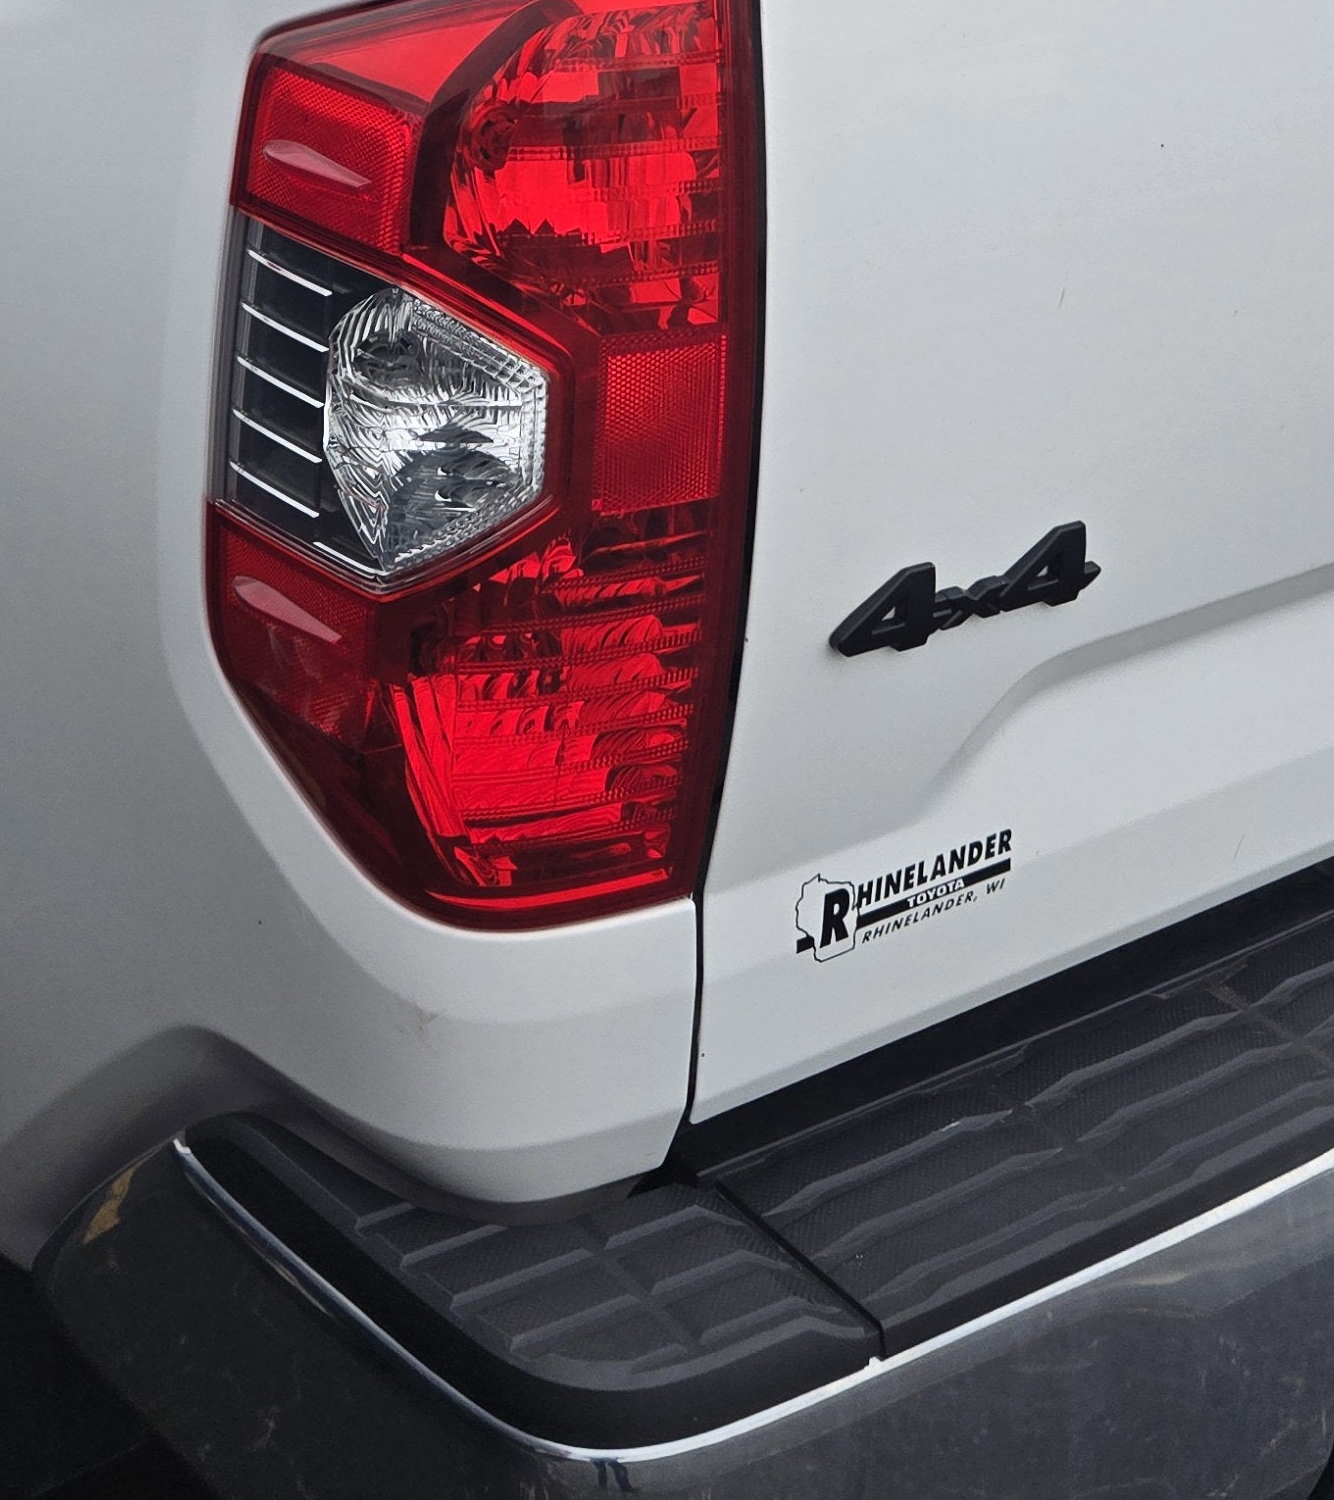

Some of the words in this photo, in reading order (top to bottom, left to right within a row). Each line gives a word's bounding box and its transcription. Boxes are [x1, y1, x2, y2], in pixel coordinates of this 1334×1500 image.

[819, 828, 1013, 949] RHINELANDER
[861, 889, 979, 944] RHINELANDER,
[985, 877, 1007, 897] WI
[906, 877, 966, 909] TOYOTA
